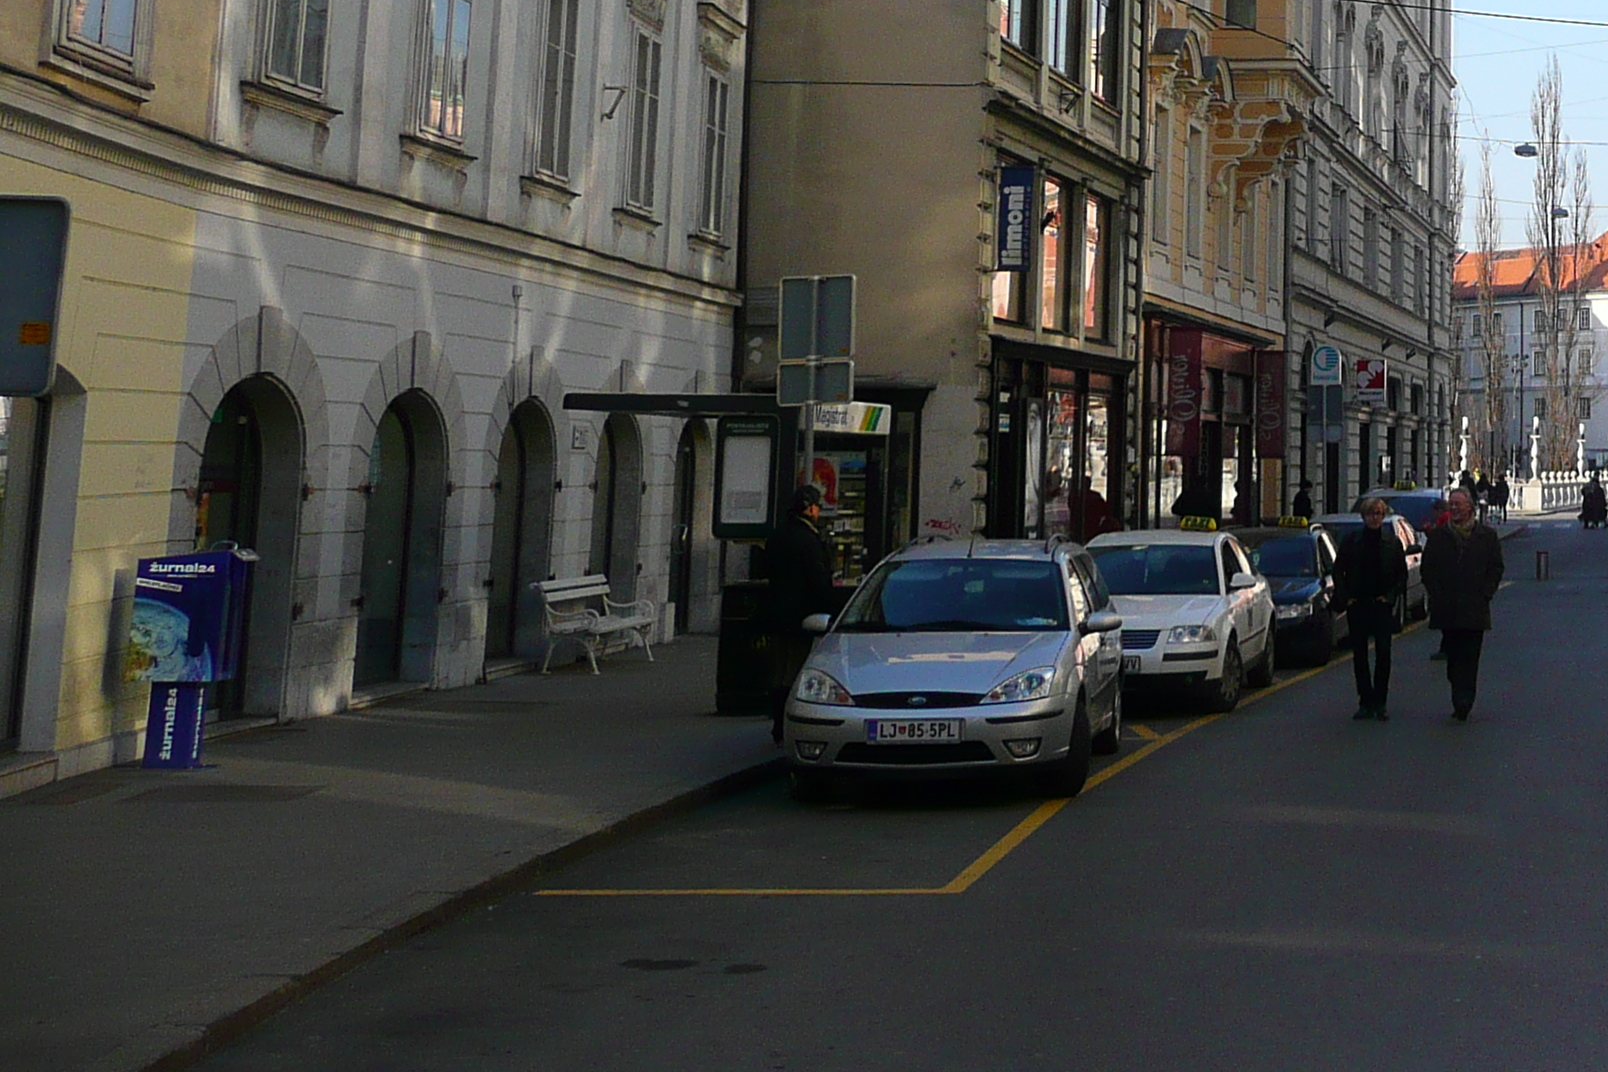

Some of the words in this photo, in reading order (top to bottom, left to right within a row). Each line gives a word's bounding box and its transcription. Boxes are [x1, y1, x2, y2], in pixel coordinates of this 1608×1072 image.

[1001, 186, 1025, 265] limoni
[149, 561, 216, 573] žurnal24
[159, 687, 178, 761] žurnal24
[880, 723, 897, 738] LJ
